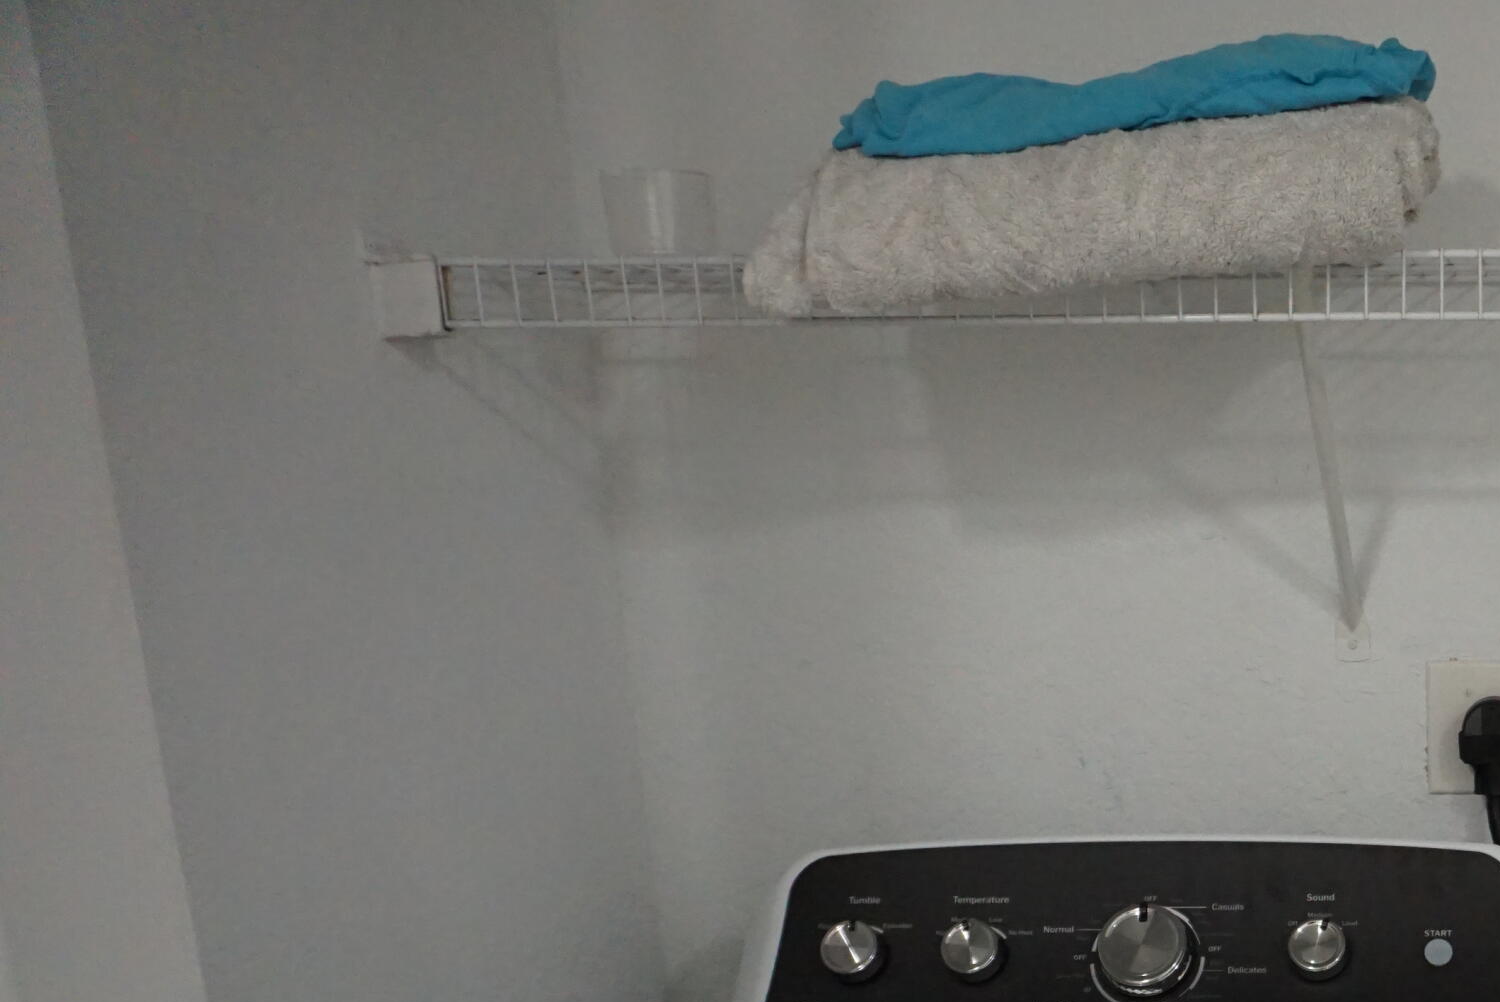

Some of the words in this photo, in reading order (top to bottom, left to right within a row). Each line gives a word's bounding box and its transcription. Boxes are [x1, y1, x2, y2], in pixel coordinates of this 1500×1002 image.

[848, 896, 881, 905] Tumble
[952, 896, 1010, 905] Temperature
[1306, 893, 1336, 902] Sound
[1211, 903, 1245, 911] Casuals
[1043, 925, 1075, 934] Normal
[1424, 929, 1453, 938] START
[1227, 966, 1268, 975] Delicates
